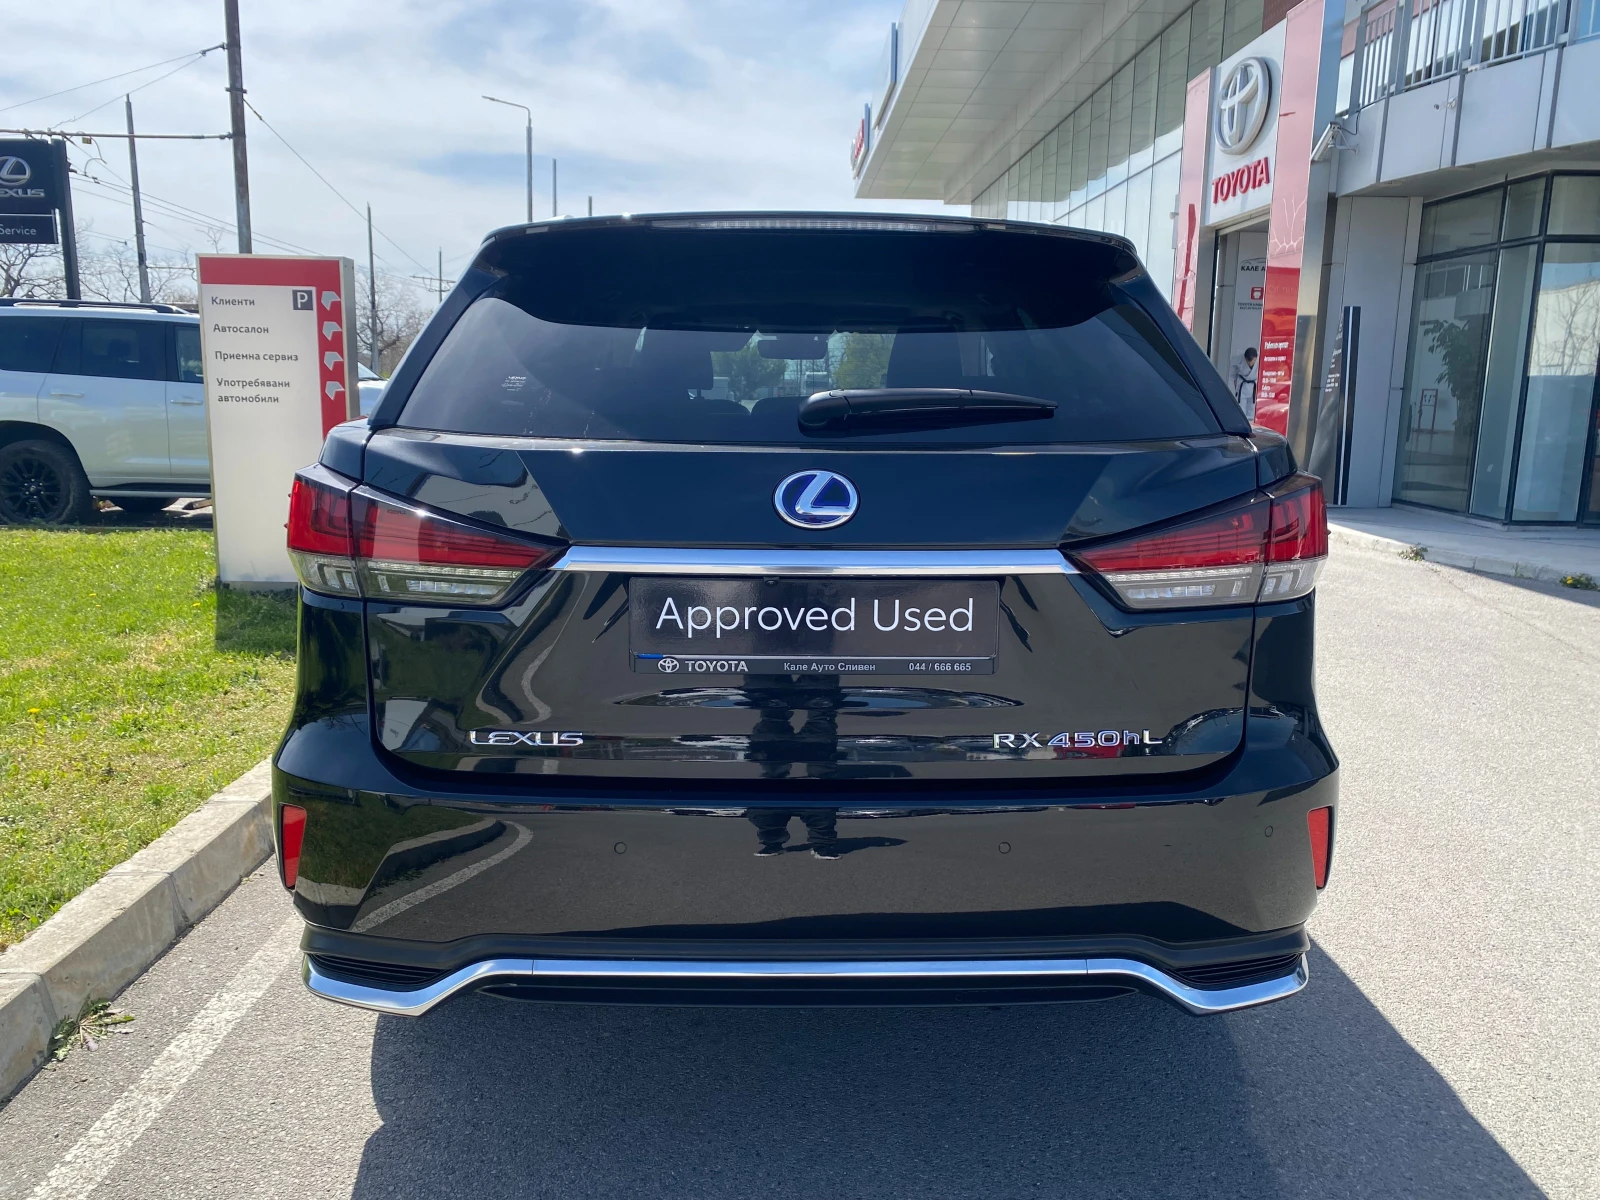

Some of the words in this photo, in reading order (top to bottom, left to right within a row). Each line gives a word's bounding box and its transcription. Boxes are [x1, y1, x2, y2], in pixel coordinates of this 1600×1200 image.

[1212, 157, 1270, 204] TOYOTA
[211, 297, 255, 306] Клиенти
[213, 324, 269, 333] Автосалон
[215, 351, 260, 361] Приемна
[263, 354, 298, 362] сервиз
[216, 378, 289, 389] Употребявани
[218, 394, 279, 402] автомобили
[656, 597, 855, 638] Approved
[873, 598, 973, 632] Used
[685, 660, 749, 673] TOYOTA
[783, 662, 808, 672] Кале
[811, 662, 837, 674] Ауто
[838, 662, 876, 672] Сливен
[908, 662, 927, 672] 044
[934, 662, 952, 672] 666
[954, 662, 972, 672] 665
[469, 730, 584, 746] LEXUS
[993, 732, 1043, 748] RX
